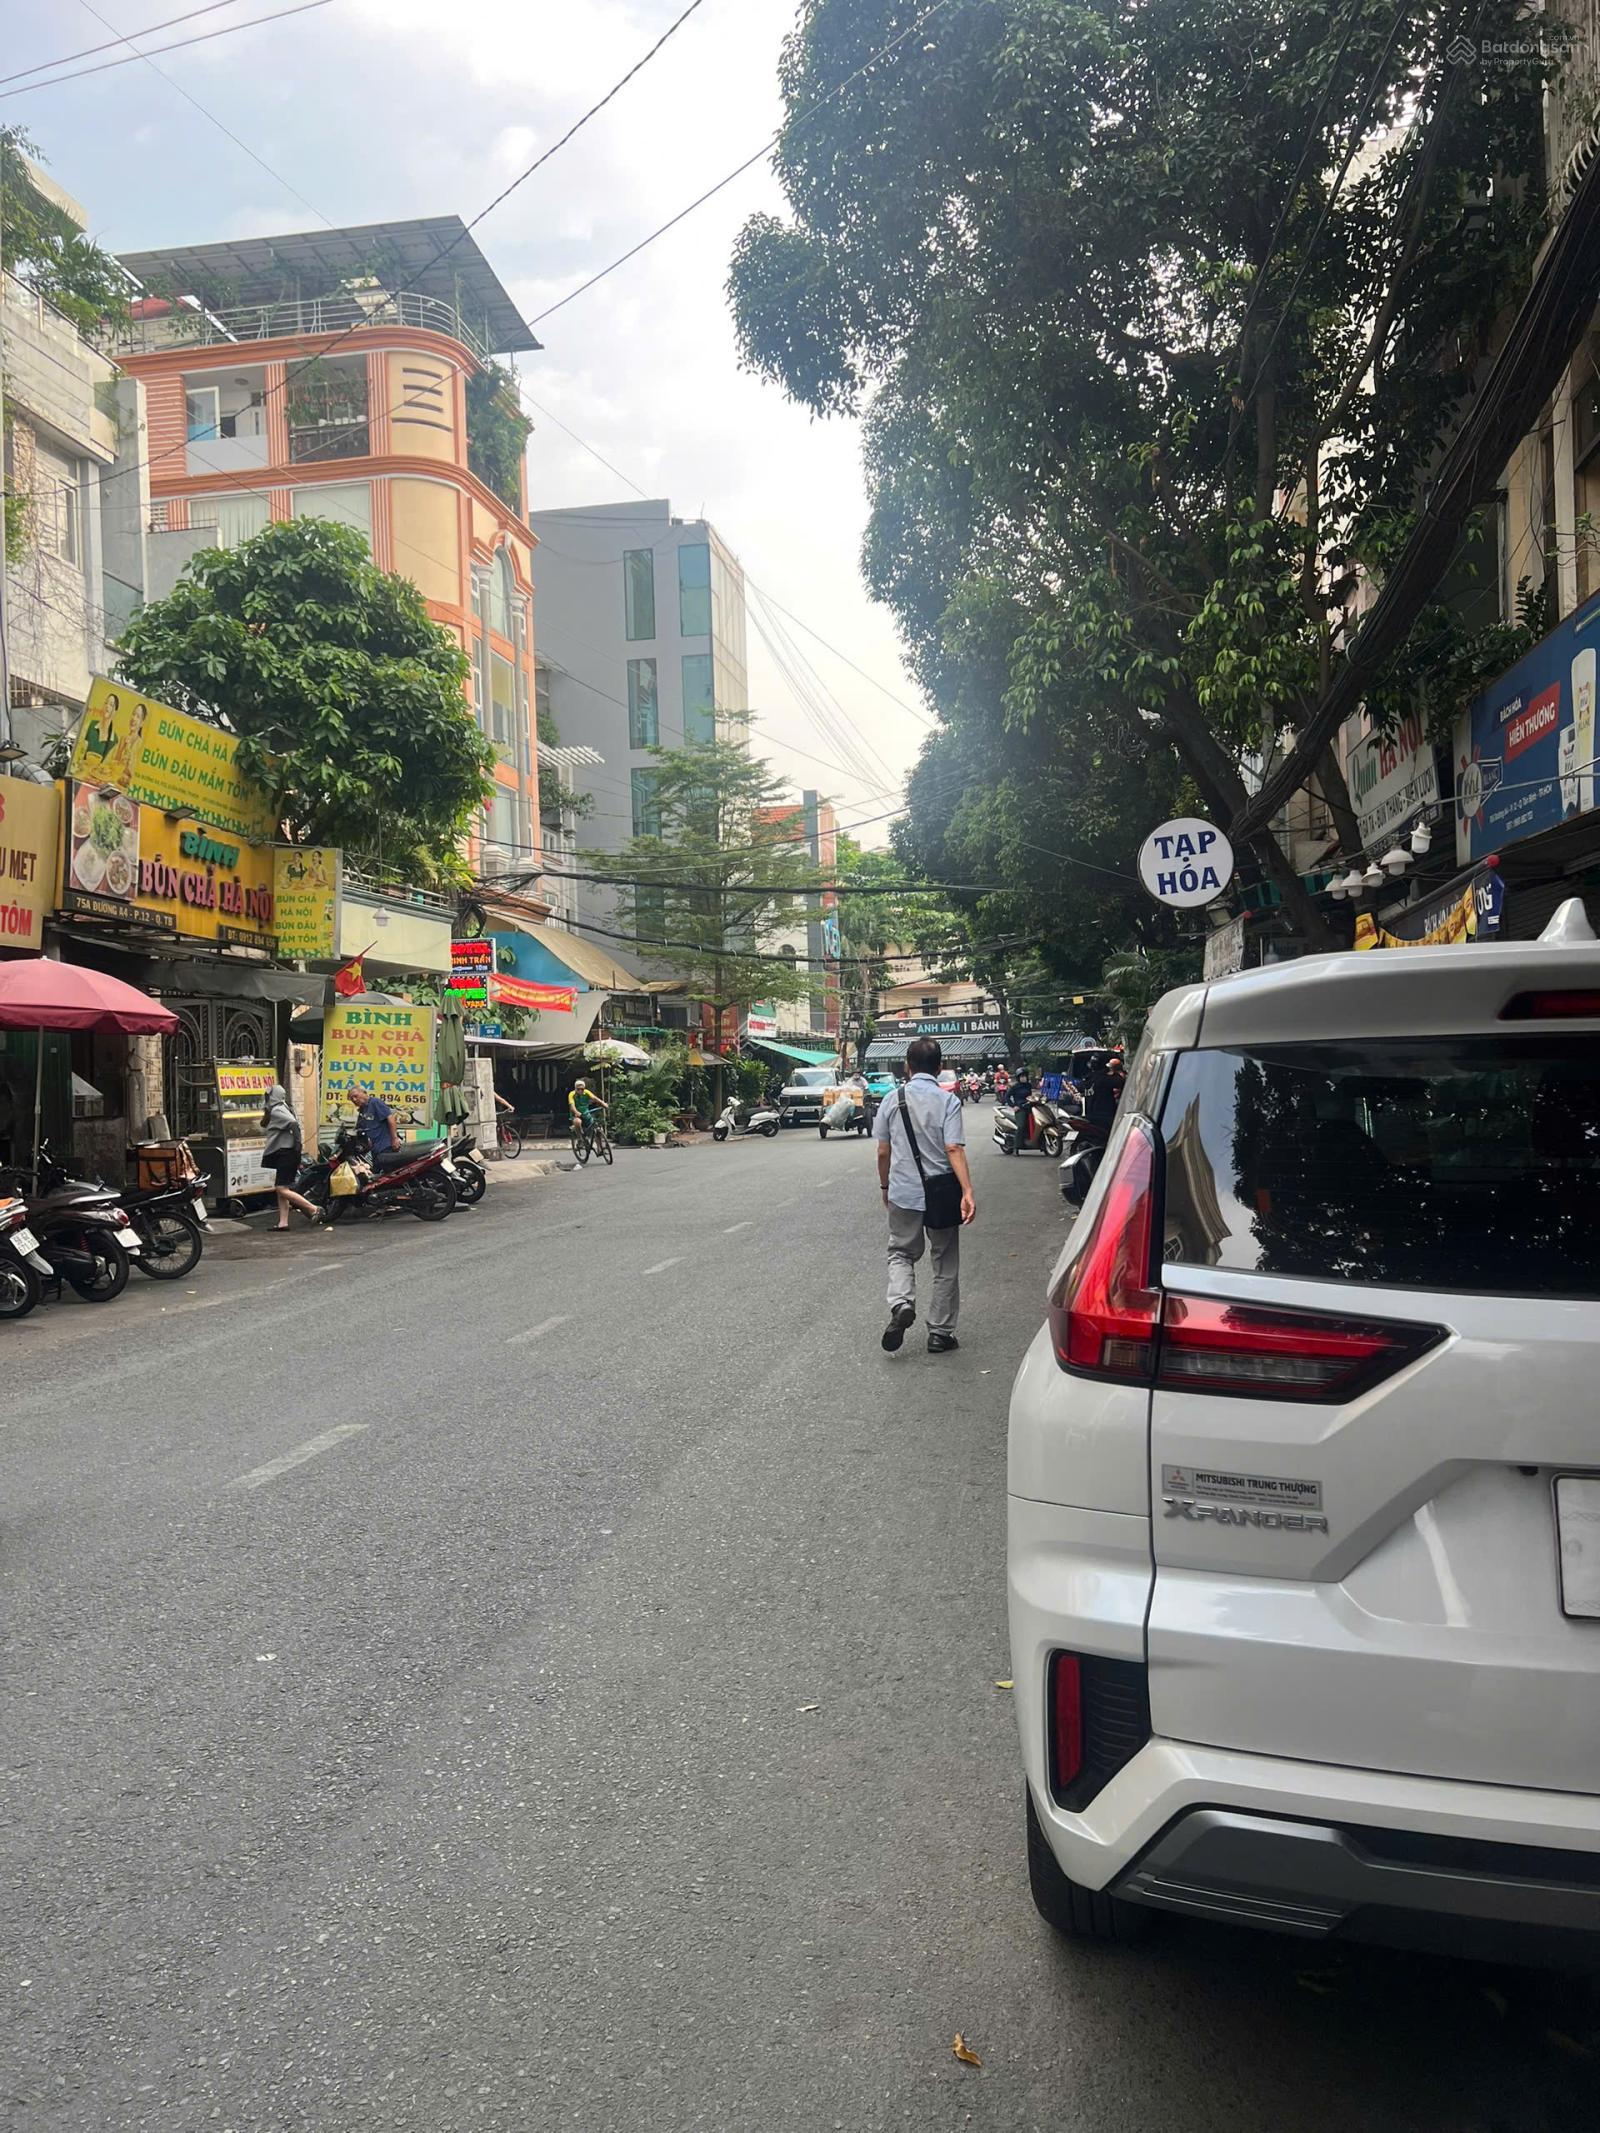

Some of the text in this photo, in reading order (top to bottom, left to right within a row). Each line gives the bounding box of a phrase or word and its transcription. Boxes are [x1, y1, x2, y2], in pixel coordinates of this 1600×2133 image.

[158, 720, 185, 744] BÚN
[186, 732, 209, 755] CHẢ
[212, 742, 228, 763] HÀ
[141, 748, 169, 771] BÚN
[171, 759, 197, 782] ĐẬU
[198, 767, 225, 793] MẮM
[182, 829, 241, 868] BÌNH
[1154, 830, 1217, 863] TẠP
[9, 849, 37, 887] MẸT
[1157, 863, 1221, 895] HÓA
[141, 854, 275, 929] BÚN CHẢ HÀ NỘI
[297, 892, 317, 903] CHẢ
[0, 899, 33, 936] TÔM
[76, 896, 92, 909] 75A
[118, 906, 128, 918] A4
[345, 1008, 412, 1025] BÌNH
[917, 1024, 939, 1033] ANH
[971, 1019, 1000, 1031] BÁNH
[331, 1026, 425, 1042] BÚN CHẢ
[340, 1042, 415, 1059] HÀ NỘI
[329, 1059, 425, 1076] BÚN ĐẬU
[220, 1073, 236, 1090] BÚN
[236, 1070, 251, 1089] CHẢ
[328, 1074, 426, 1092] MẮM TÔM
[326, 1092, 343, 1101] ĐT:
[405, 1095, 427, 1104] 656
[1196, 1473, 1245, 1488] MITSUBISHI
[1247, 1479, 1277, 1490] TRUNG
[1278, 1480, 1317, 1495] THƯỢNG
[1161, 1497, 1329, 1536] XPANDER
